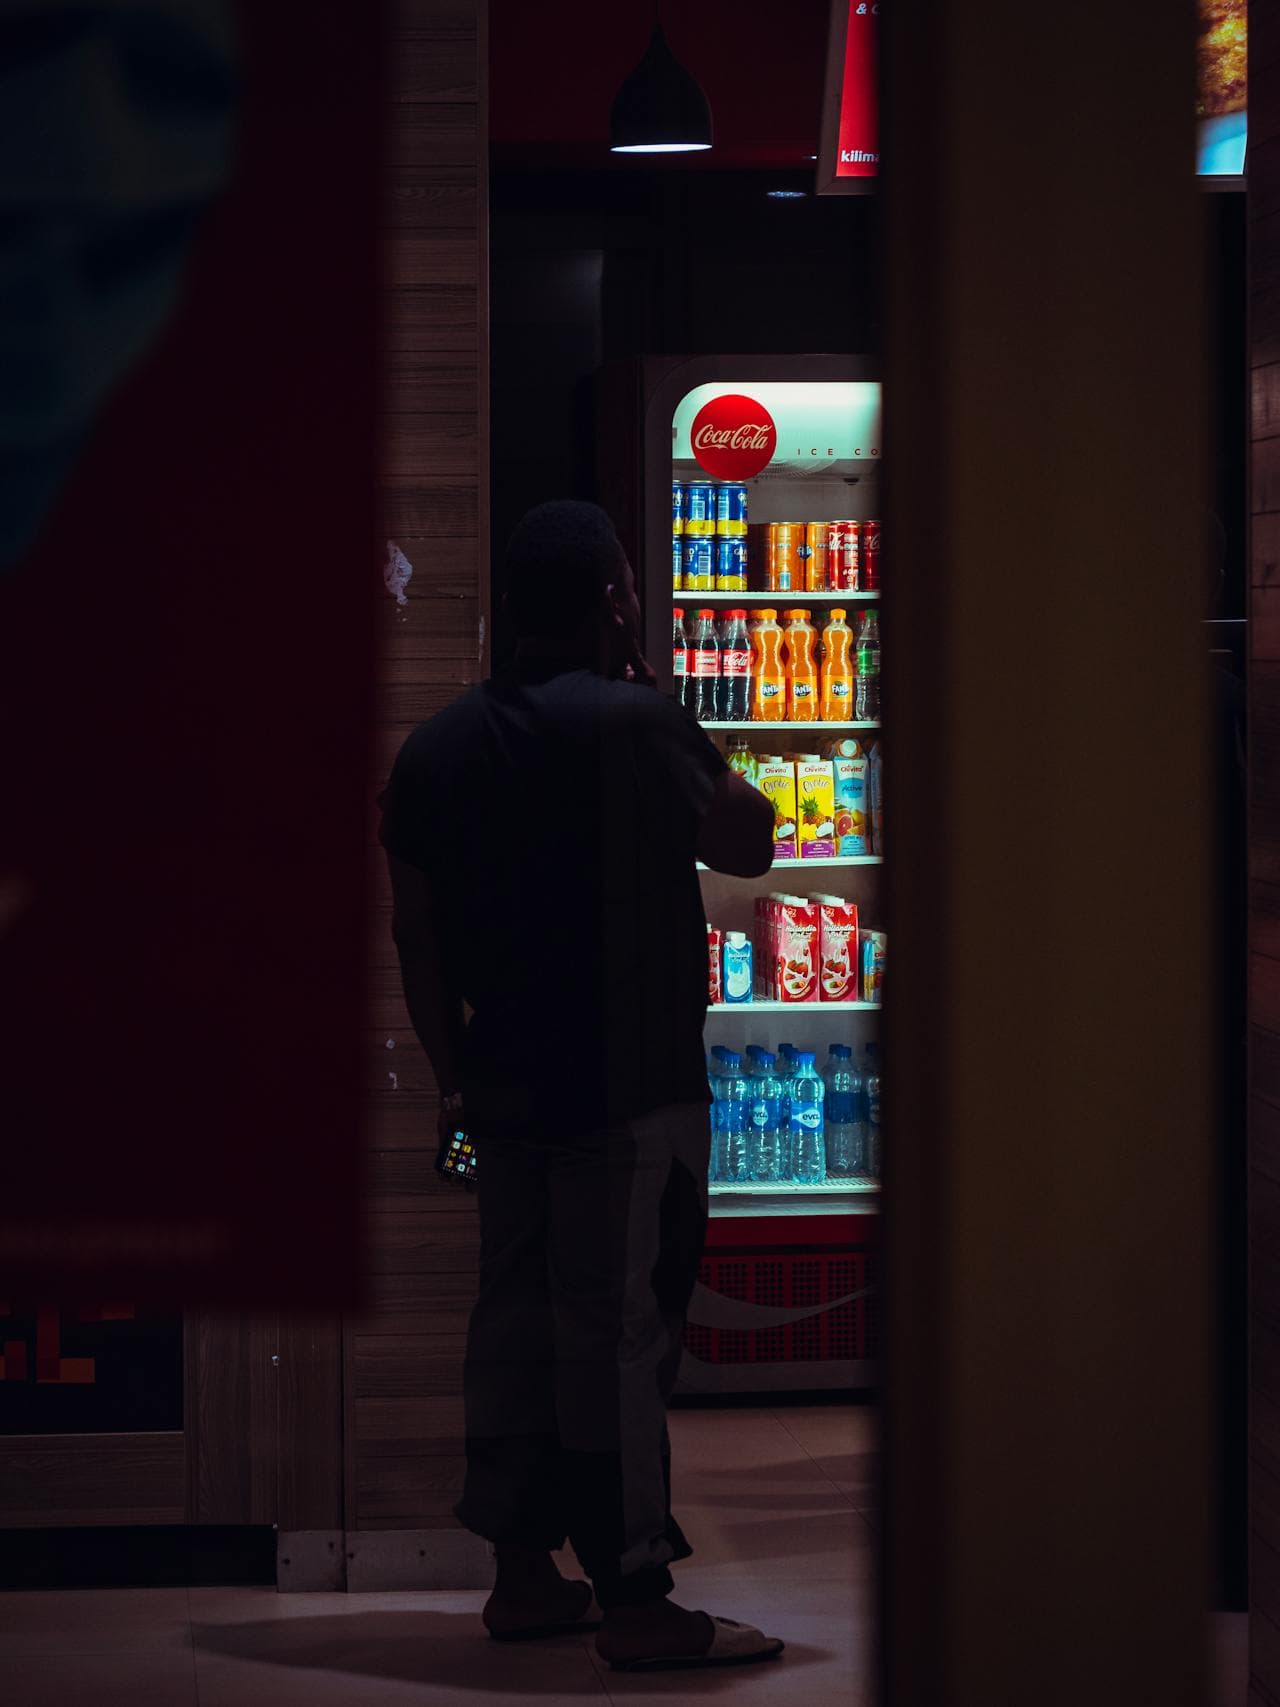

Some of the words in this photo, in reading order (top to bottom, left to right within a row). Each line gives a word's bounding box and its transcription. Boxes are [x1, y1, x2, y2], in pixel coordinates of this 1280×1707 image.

[856, 3, 867, 15] &
[695, 424, 772, 450] Coca-Cola
[797, 448, 834, 456] ICE
